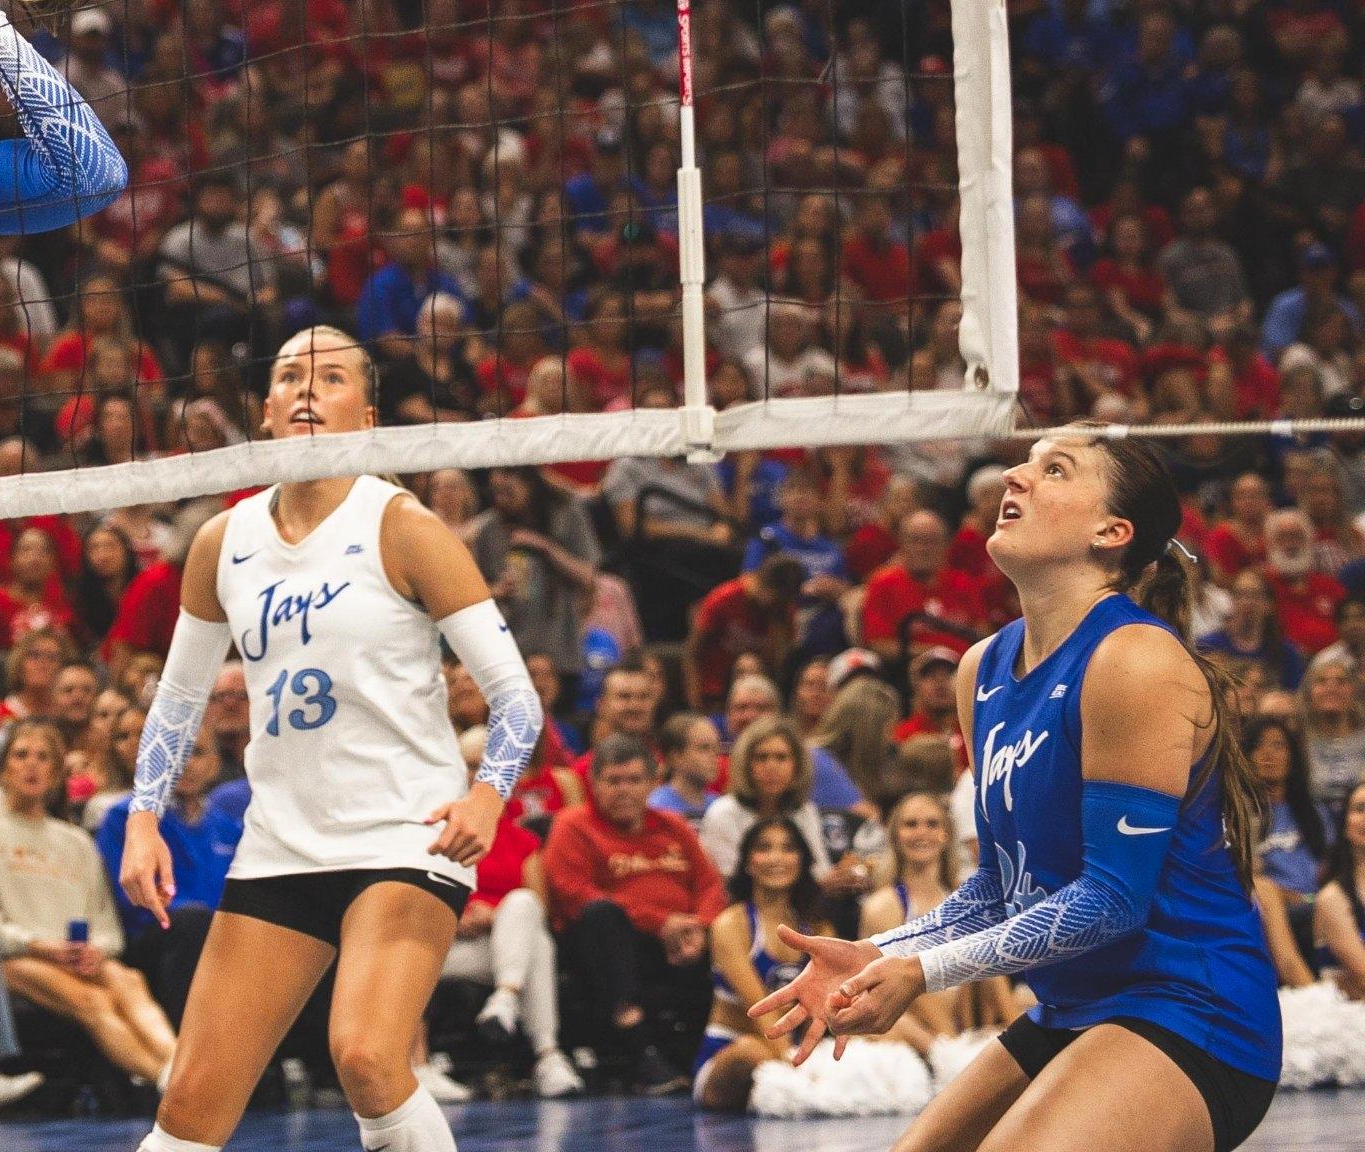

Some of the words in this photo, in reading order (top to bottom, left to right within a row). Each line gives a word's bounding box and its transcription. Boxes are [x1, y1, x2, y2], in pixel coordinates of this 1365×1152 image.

[242, 578, 351, 662] Jays
[265, 668, 338, 737] 13
[974, 721, 1049, 824] Jays
